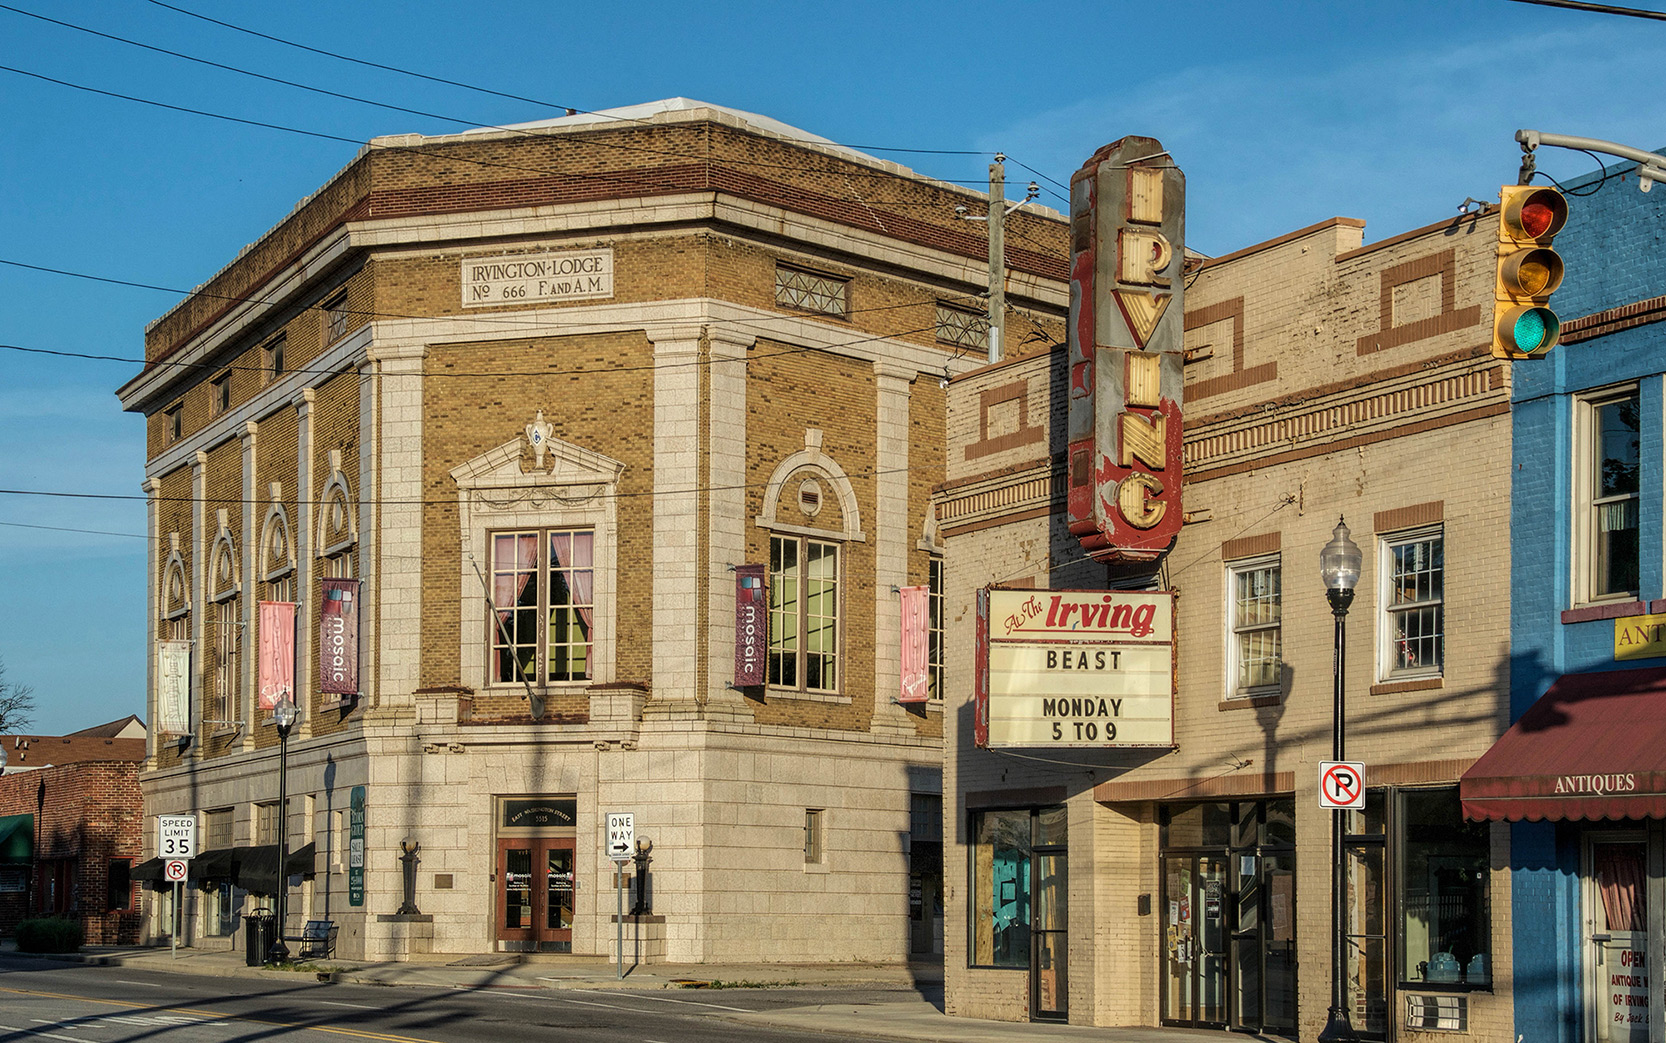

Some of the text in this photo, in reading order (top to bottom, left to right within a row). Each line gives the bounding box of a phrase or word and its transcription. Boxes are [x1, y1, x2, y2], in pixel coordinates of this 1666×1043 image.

[472, 257, 603, 282] IRVINGTON LODGE
[502, 285, 526, 298] 666
[551, 282, 571, 295] AND
[1111, 166, 1173, 531] IRVING
[1004, 595, 1157, 638] At The Irving
[744, 605, 757, 673] mosaic
[333, 617, 347, 682] mosaic
[1047, 650, 1121, 670] BEAST
[1043, 698, 1122, 717] MONDAY
[1052, 722, 1117, 741] 5 TO 9
[1554, 773, 1635, 795] ANTIQUES
[162, 819, 193, 828] SPEED
[611, 817, 631, 828] ONE
[164, 829, 189, 837] LIMIT
[611, 830, 632, 840] WAY
[165, 838, 189, 854] 35
[1621, 950, 1646, 968] OPEN
[1611, 974, 1642, 988] ANTIQUE
[1612, 993, 1623, 1006] OF
[1614, 1012, 1625, 1024] By
[1626, 1013, 1643, 1024] Jack
